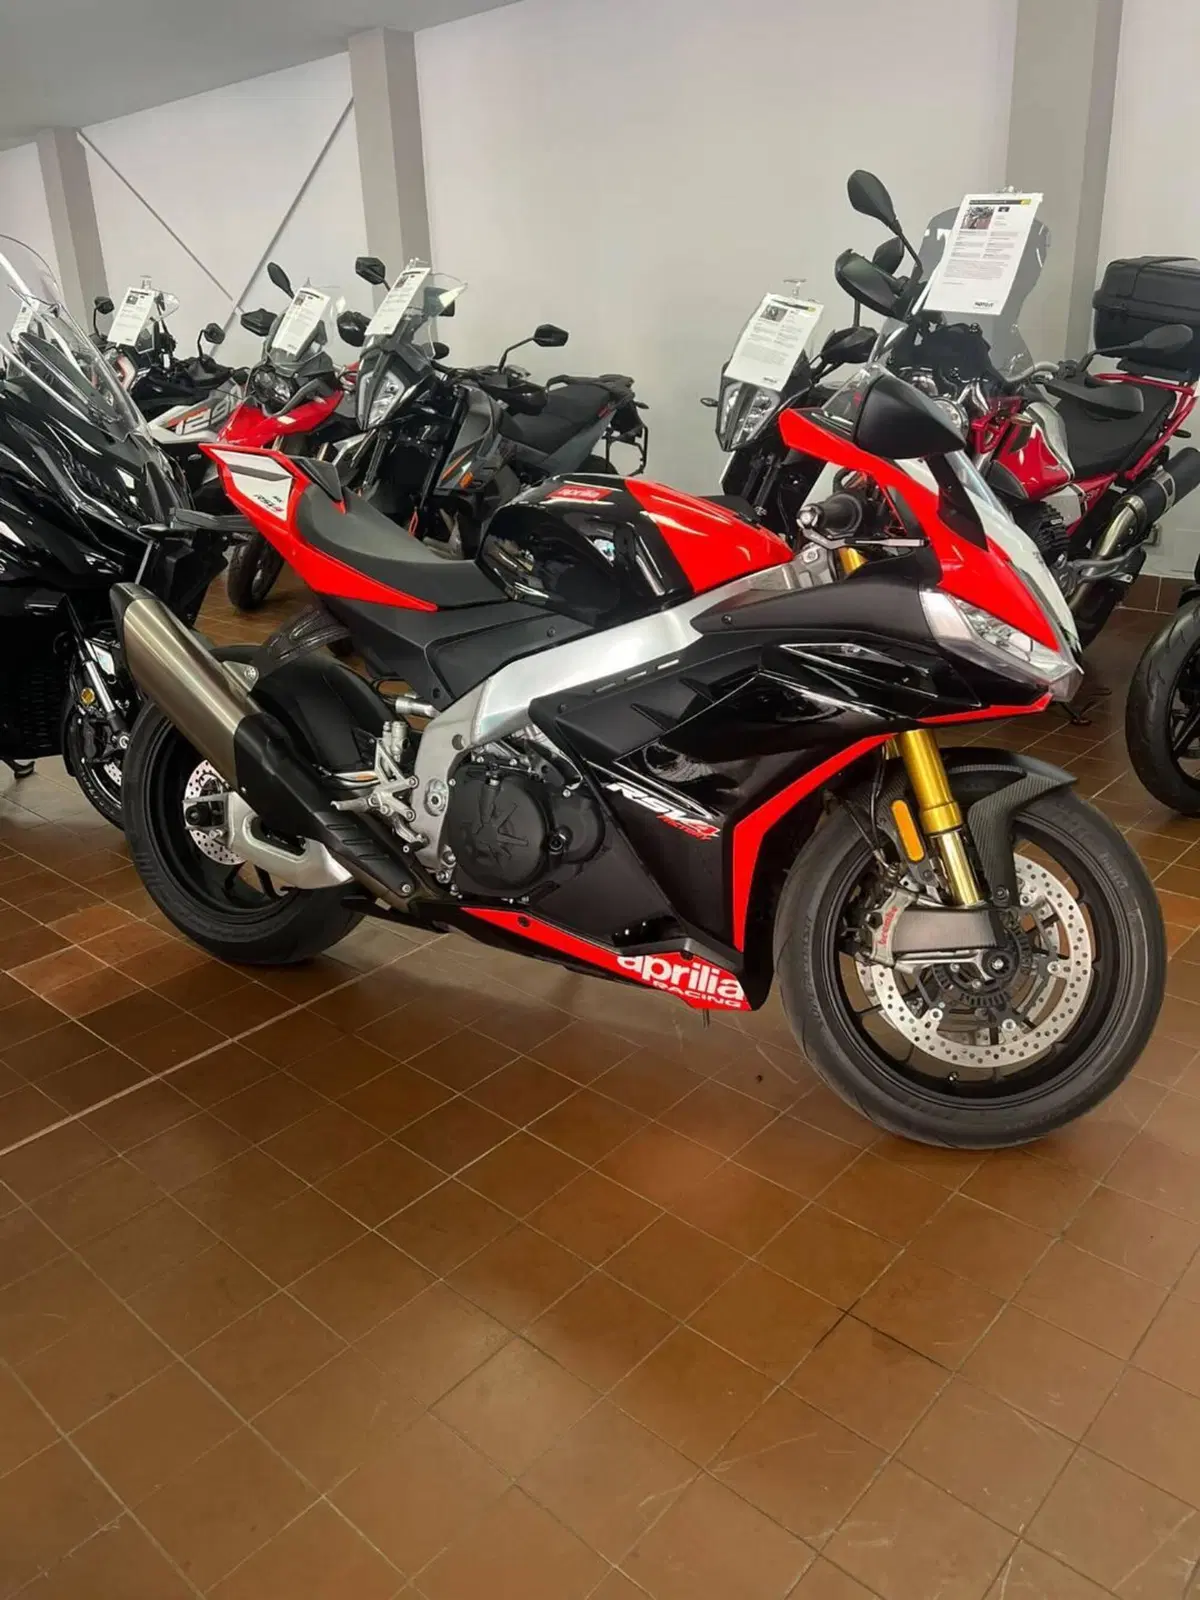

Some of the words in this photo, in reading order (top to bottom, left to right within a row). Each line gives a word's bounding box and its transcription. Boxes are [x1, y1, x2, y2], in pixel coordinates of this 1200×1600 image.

[606, 782, 720, 837] RSV4
[878, 904, 899, 945] brembo
[617, 954, 745, 1001] aprilia
[652, 980, 742, 1008] RACING
